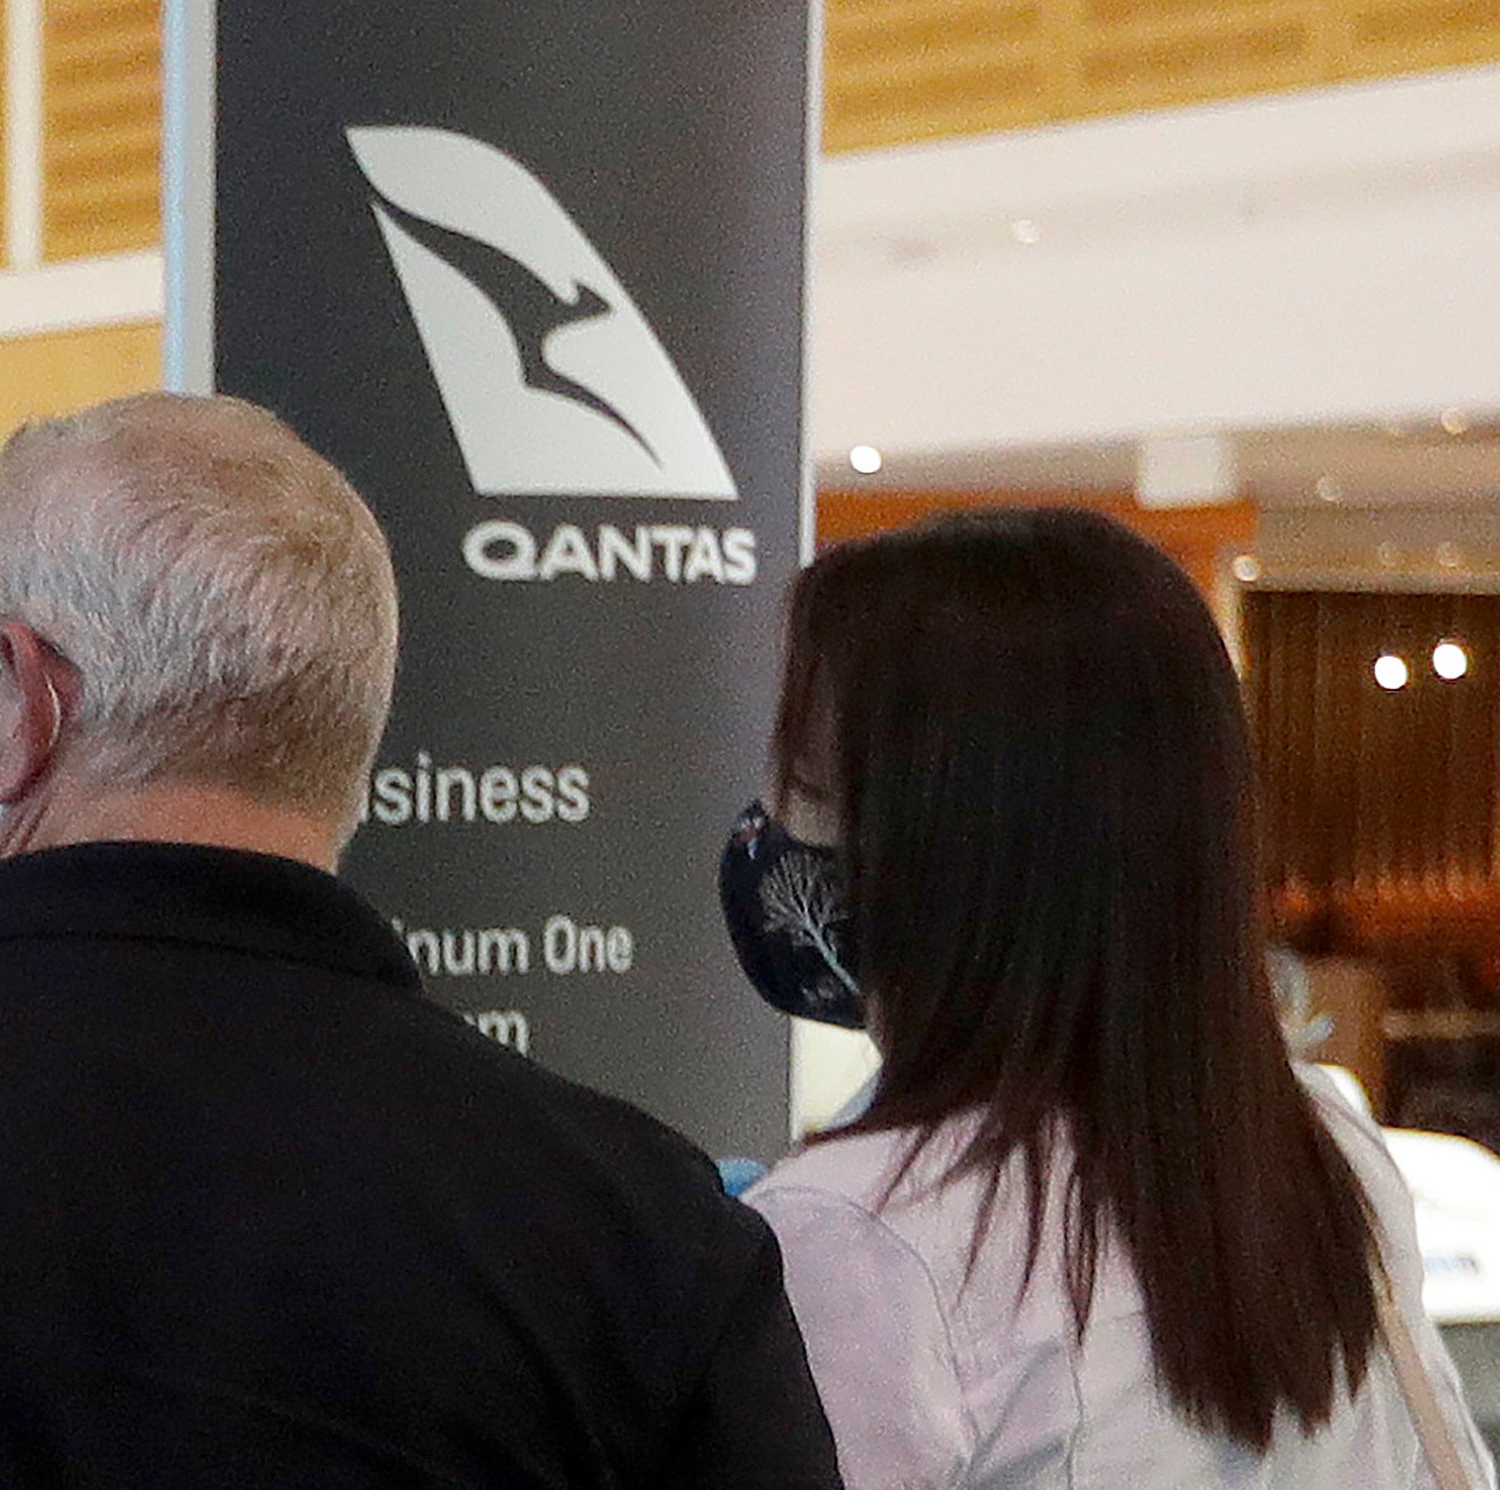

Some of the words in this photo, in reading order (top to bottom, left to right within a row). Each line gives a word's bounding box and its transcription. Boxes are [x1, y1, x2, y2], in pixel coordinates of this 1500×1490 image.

[462, 520, 758, 586] QANTAS
[363, 751, 591, 823] siness
[391, 916, 531, 976] num
[544, 914, 635, 975] One
